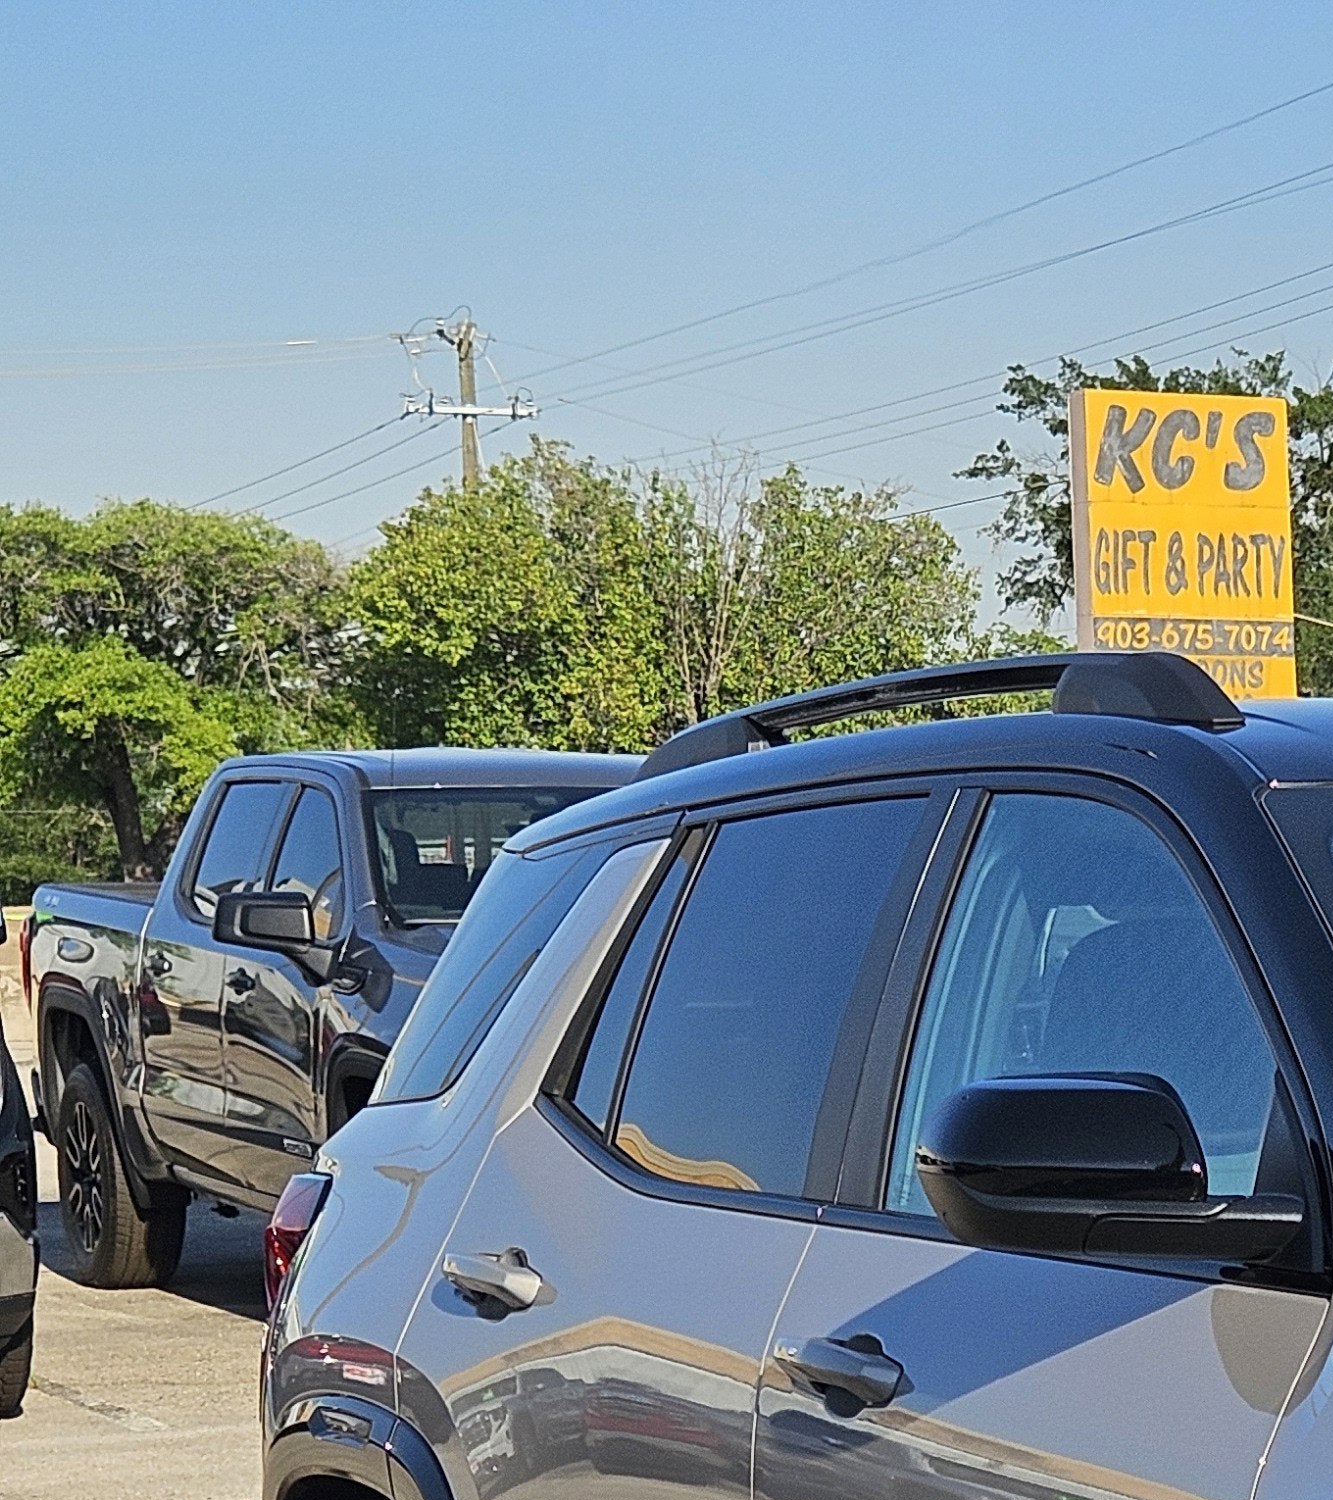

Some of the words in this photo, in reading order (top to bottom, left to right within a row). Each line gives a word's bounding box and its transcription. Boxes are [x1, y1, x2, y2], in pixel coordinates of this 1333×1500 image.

[1094, 404, 1277, 494] KC'S
[1094, 527, 1157, 596] GIFT
[1164, 530, 1189, 597] &
[1196, 532, 1286, 599] PARTY
[1097, 621, 1292, 650] 903-675-7074
